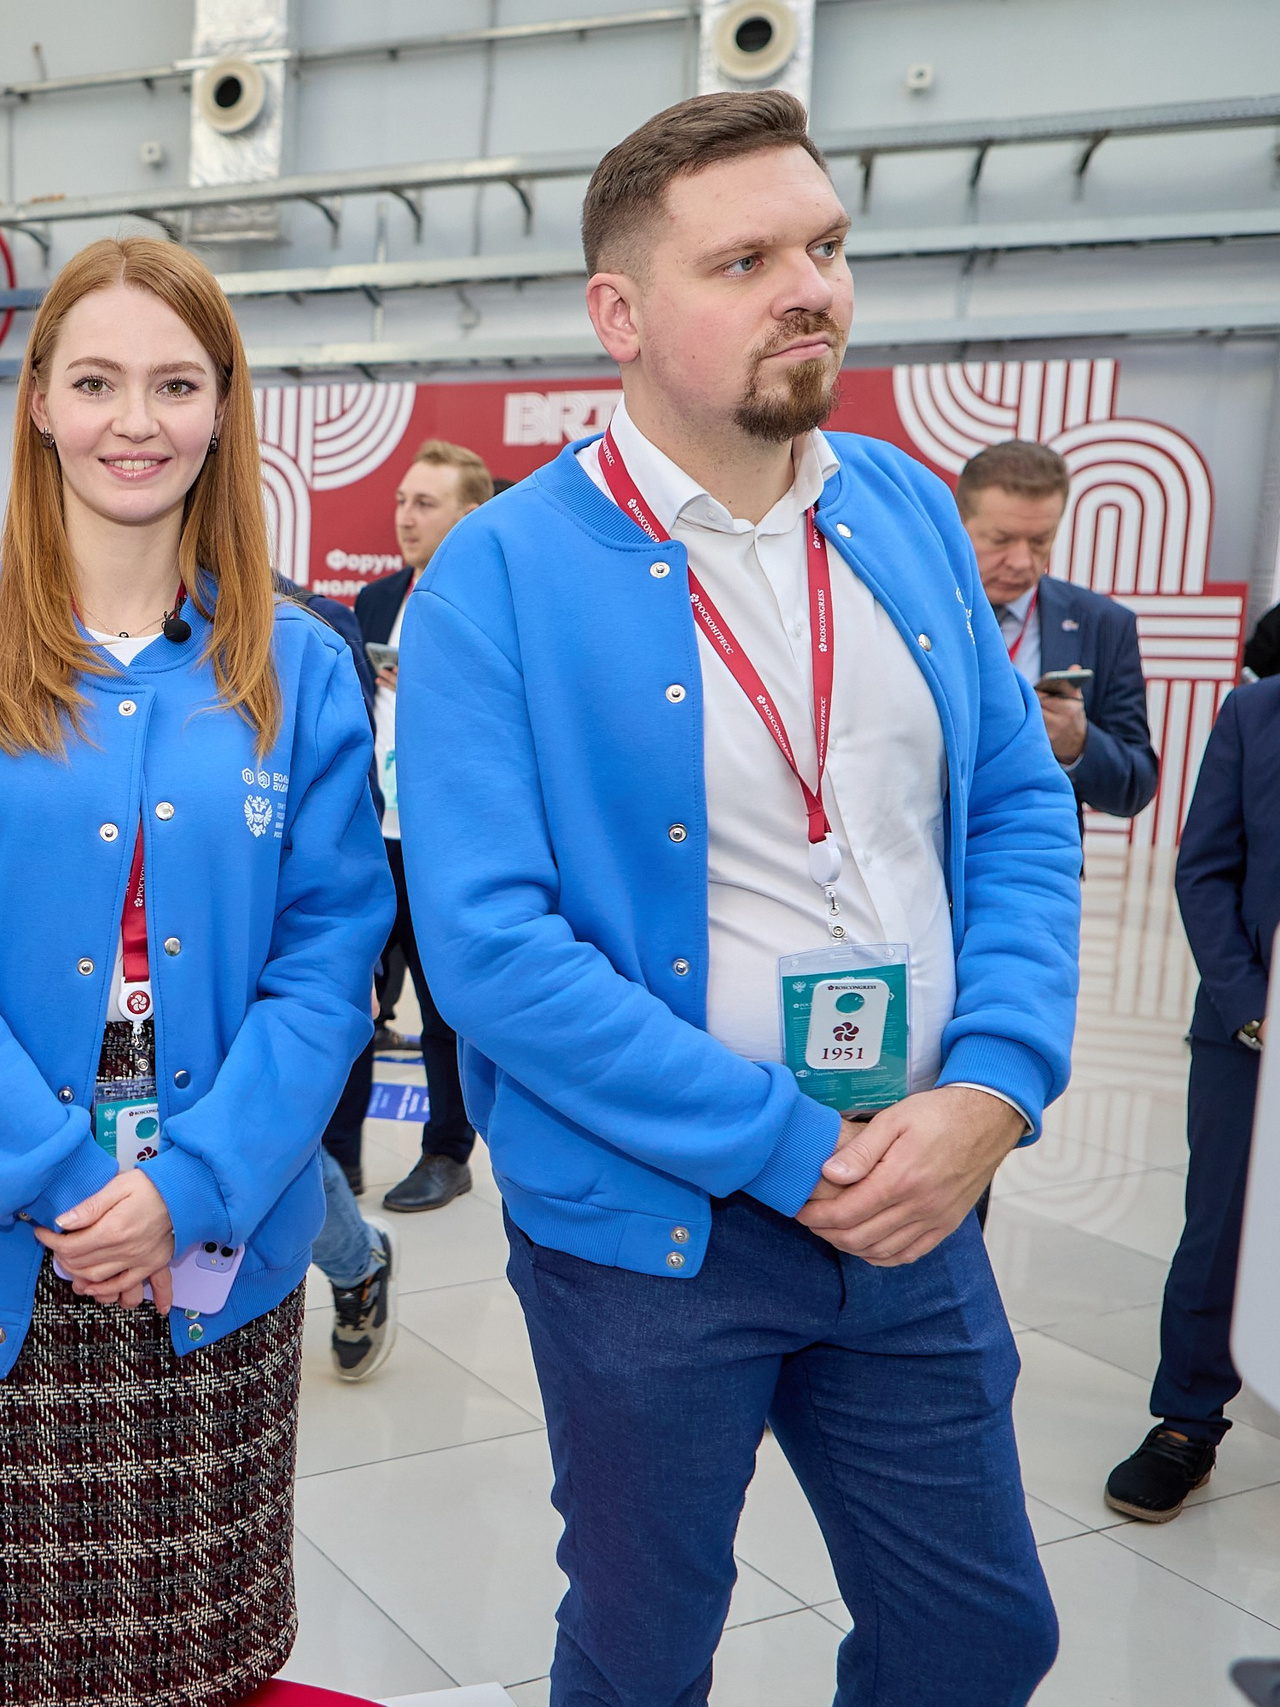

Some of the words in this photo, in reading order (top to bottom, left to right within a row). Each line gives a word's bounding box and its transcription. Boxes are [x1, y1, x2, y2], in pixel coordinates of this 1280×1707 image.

[326, 549, 403, 575] Форум
[695, 601, 735, 655] РОСКОНГРЕСС
[817, 589, 825, 643] ROSCONGRESS
[762, 703, 793, 762] ROSCONGRESS
[821, 1047, 864, 1061] 1951
